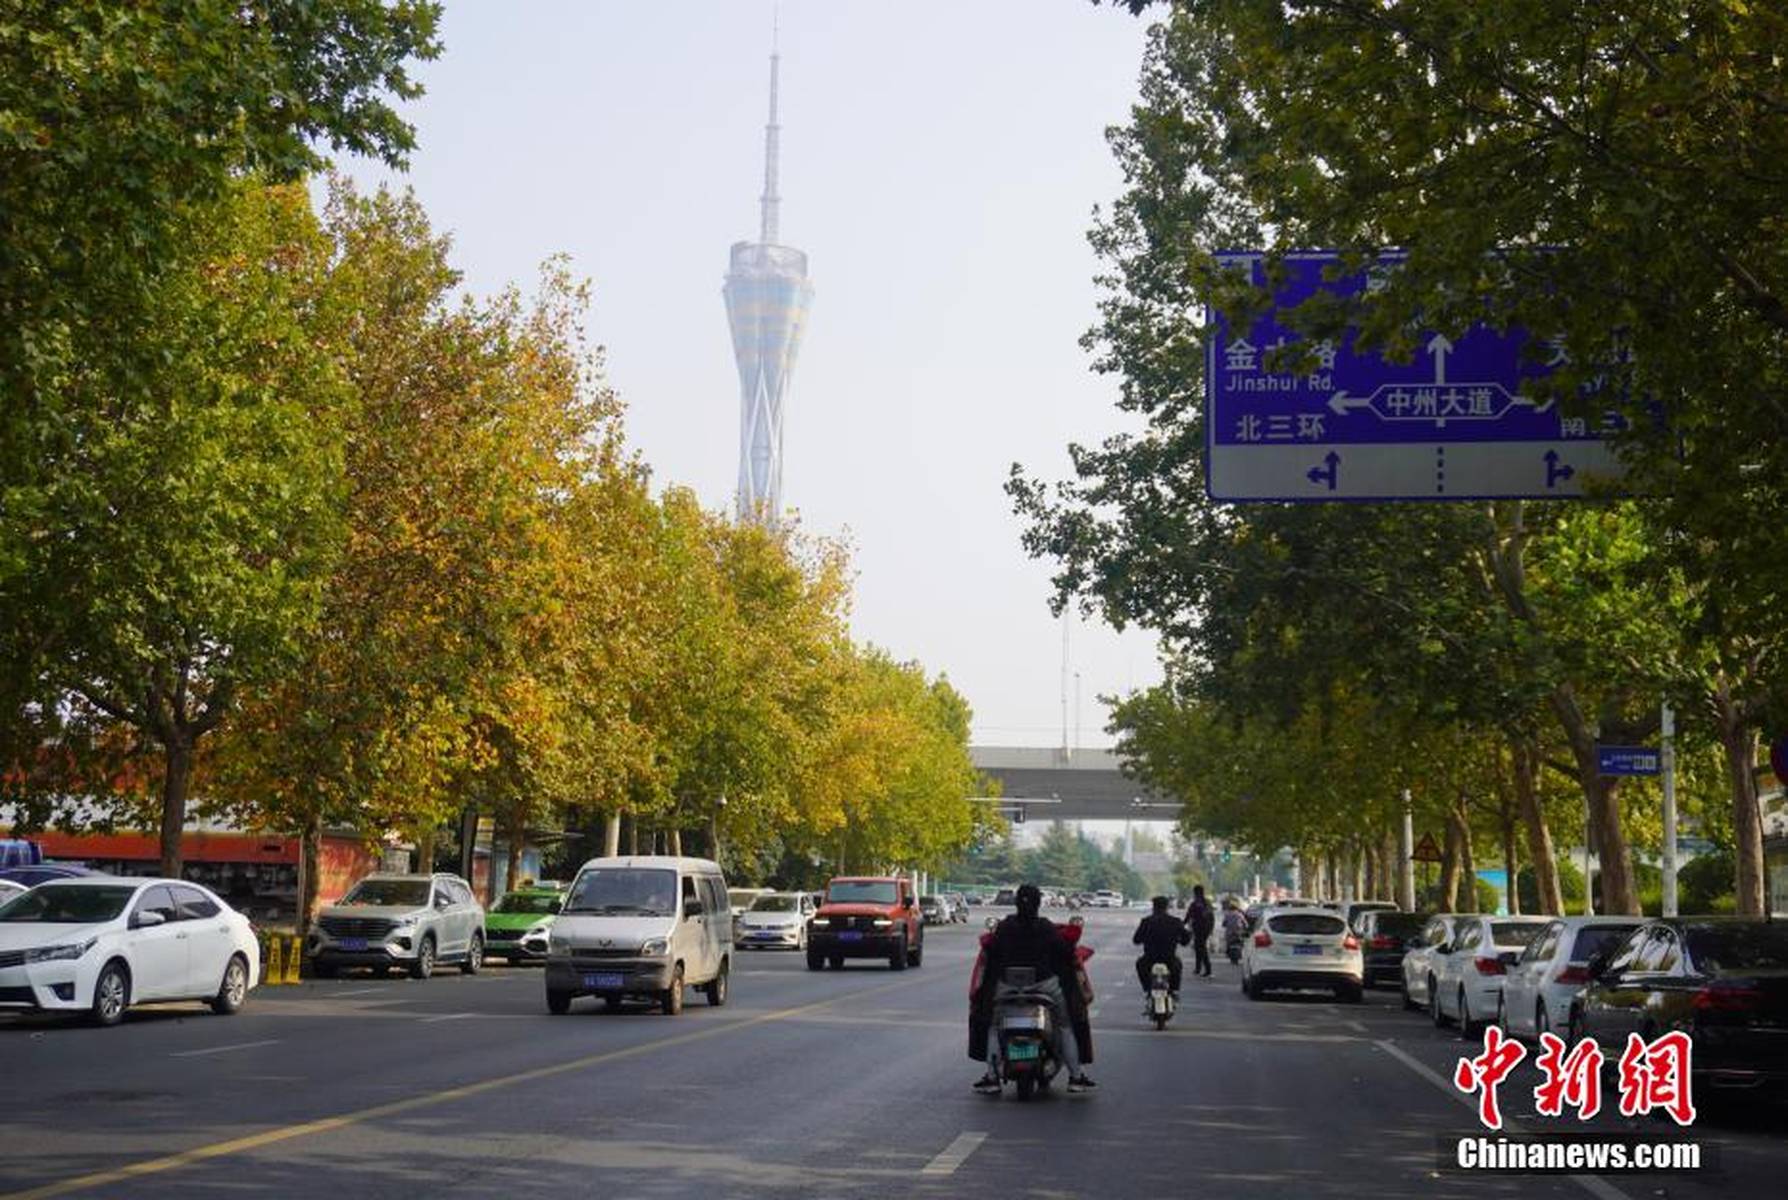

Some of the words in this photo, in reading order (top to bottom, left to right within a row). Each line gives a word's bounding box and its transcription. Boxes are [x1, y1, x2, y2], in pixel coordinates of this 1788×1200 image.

[1309, 375, 1336, 392] Rd.
[1387, 386, 1493, 416] 中州大道
[1236, 414, 1325, 441] 北三环
